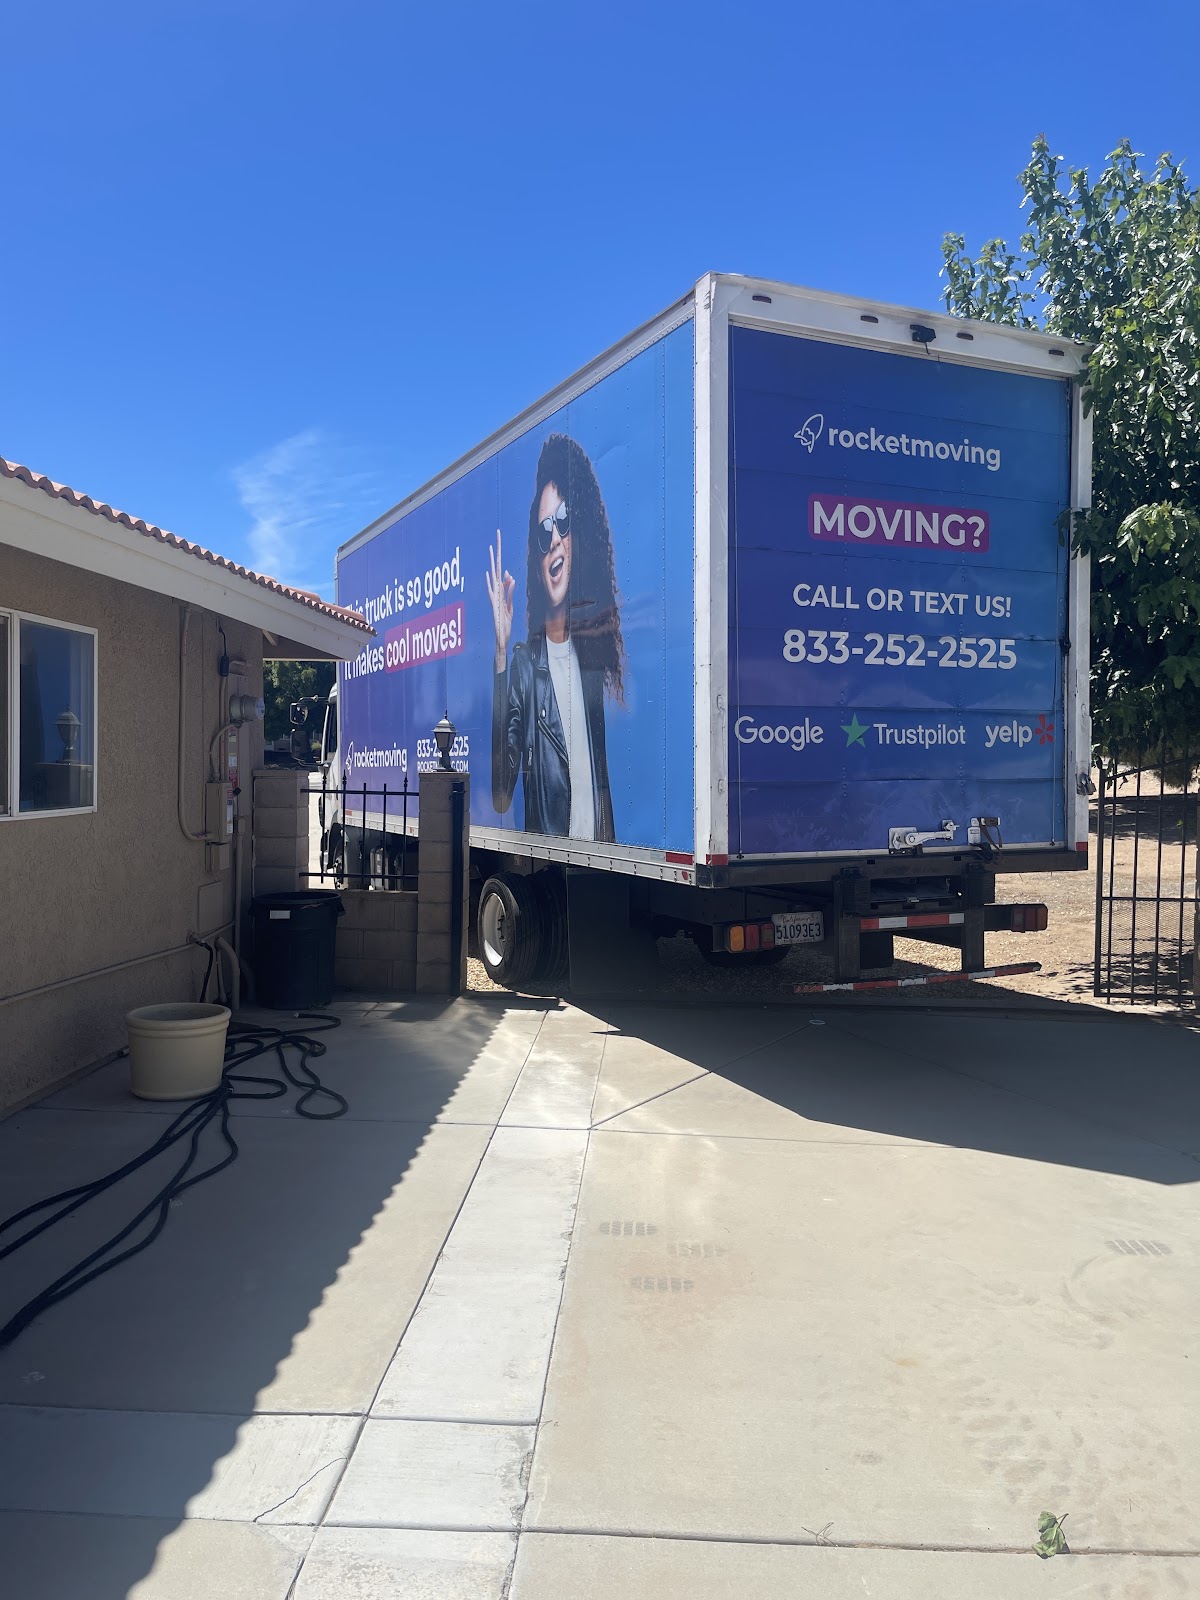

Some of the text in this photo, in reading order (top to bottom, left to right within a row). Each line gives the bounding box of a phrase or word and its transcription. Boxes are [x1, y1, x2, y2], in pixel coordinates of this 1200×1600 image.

[829, 427, 1000, 471] rocketmoving
[813, 501, 985, 547] MOVING?
[365, 585, 393, 626] truck
[395, 578, 404, 612] is
[407, 576, 421, 608] so
[424, 546, 464, 609] good,
[793, 583, 1012, 619] CALL OR TEXT US!
[386, 628, 410, 668] cool
[412, 608, 462, 660] moves!
[782, 629, 1017, 670] 833-252-2525
[734, 715, 1032, 752] Google Trustpilot yelp
[354, 742, 407, 772] rocketmoving
[776, 922, 821, 939] 51093E3
